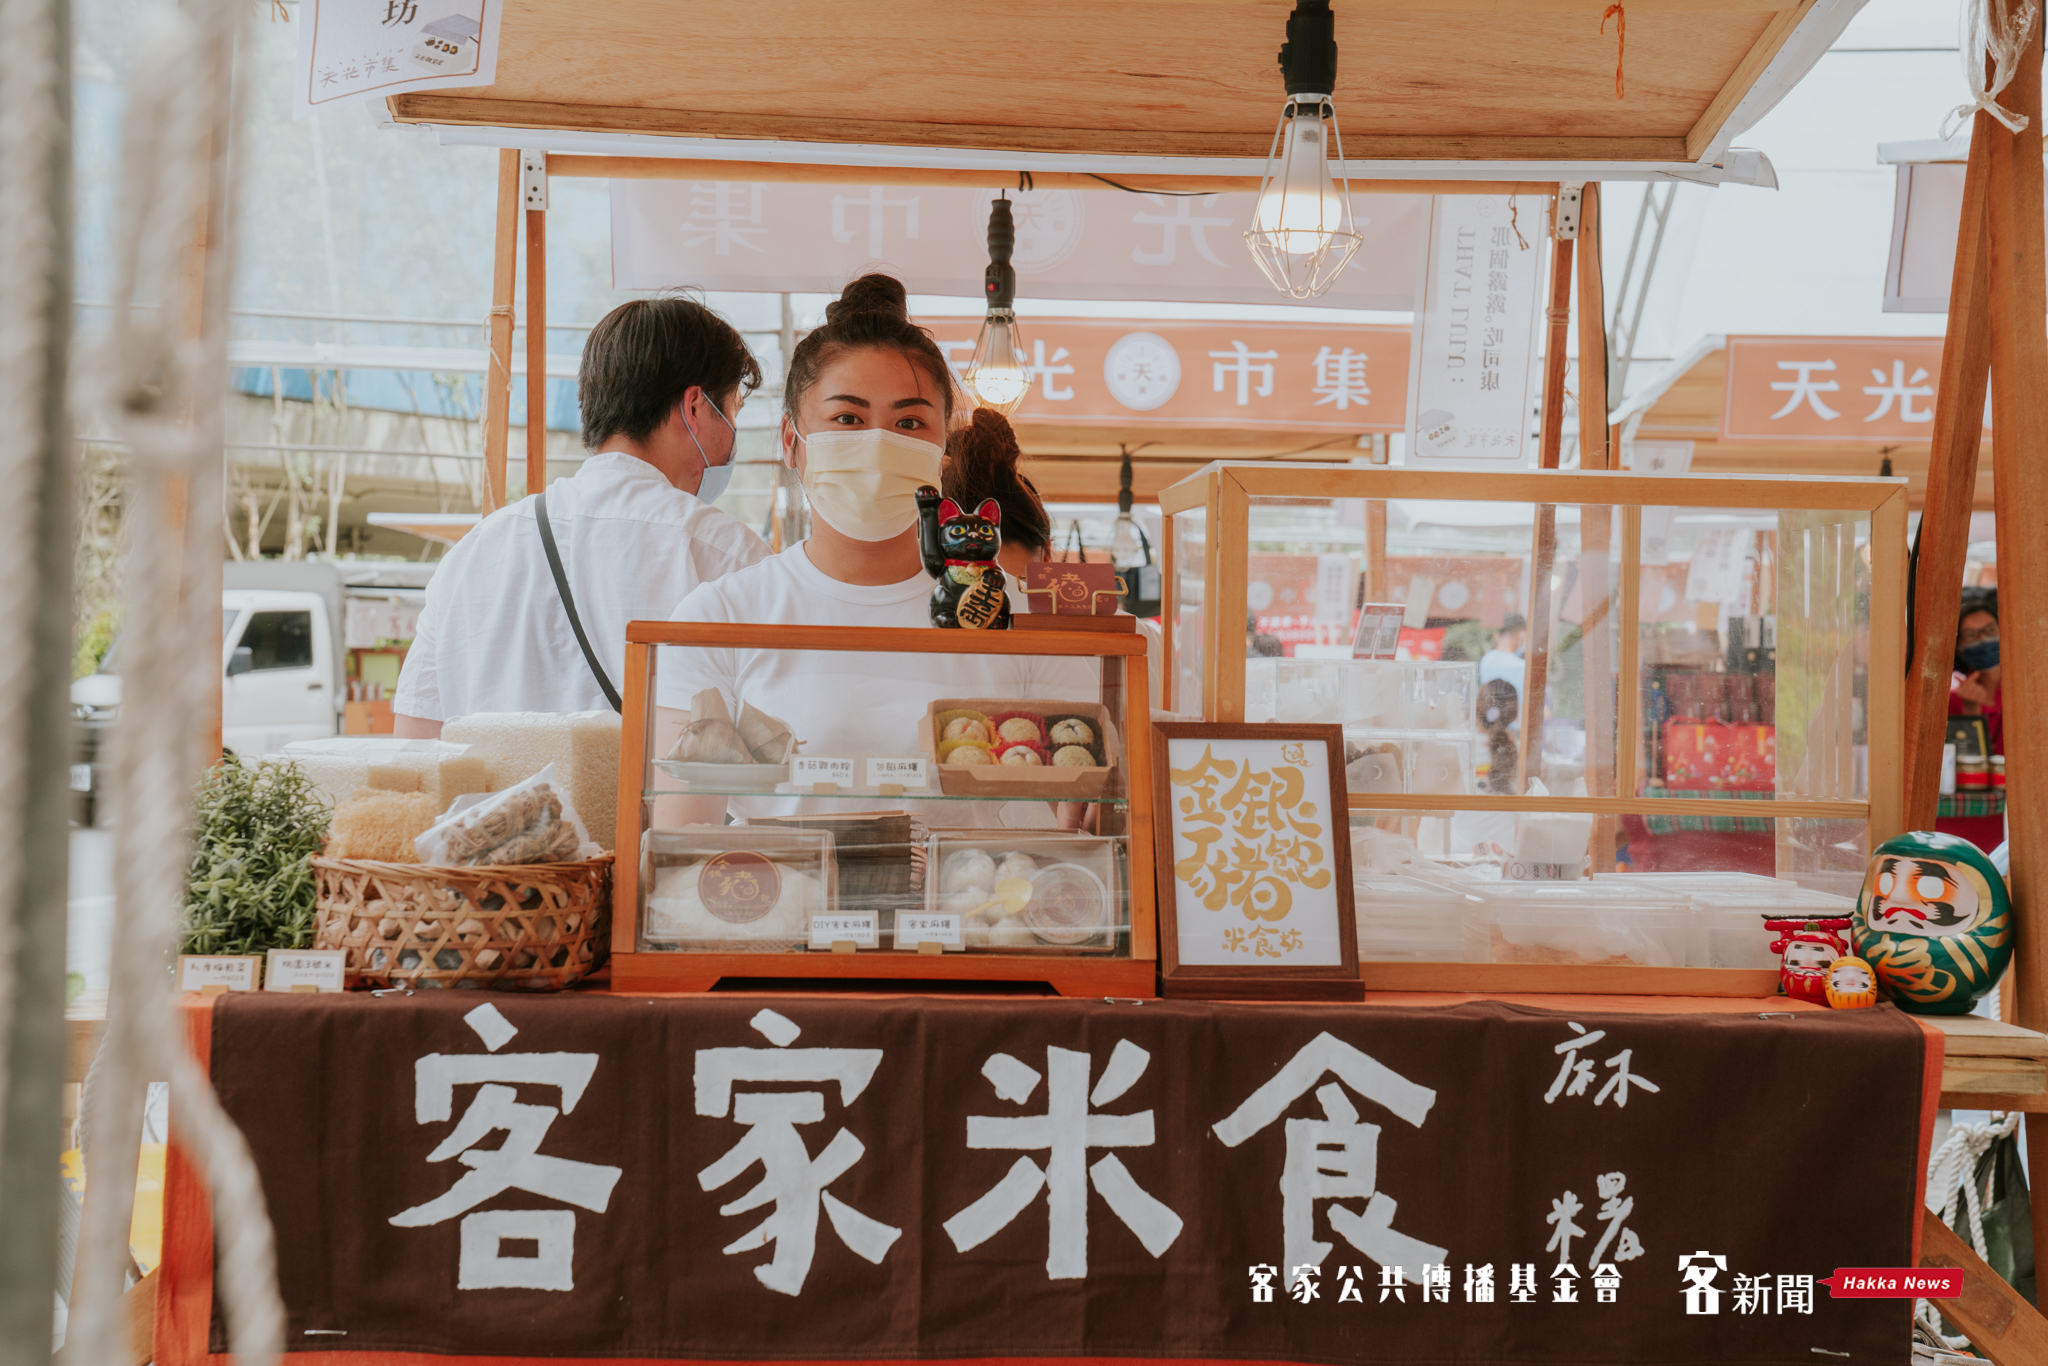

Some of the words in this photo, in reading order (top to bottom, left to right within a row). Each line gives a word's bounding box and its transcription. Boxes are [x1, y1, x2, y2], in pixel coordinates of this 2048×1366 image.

[318, 56, 401, 88] 天光市集
[1207, 339, 1372, 410] 市集
[1769, 358, 1936, 423] 天光
[1222, 924, 1303, 958] 米食坊
[389, 1002, 1450, 1297] 客家米食
